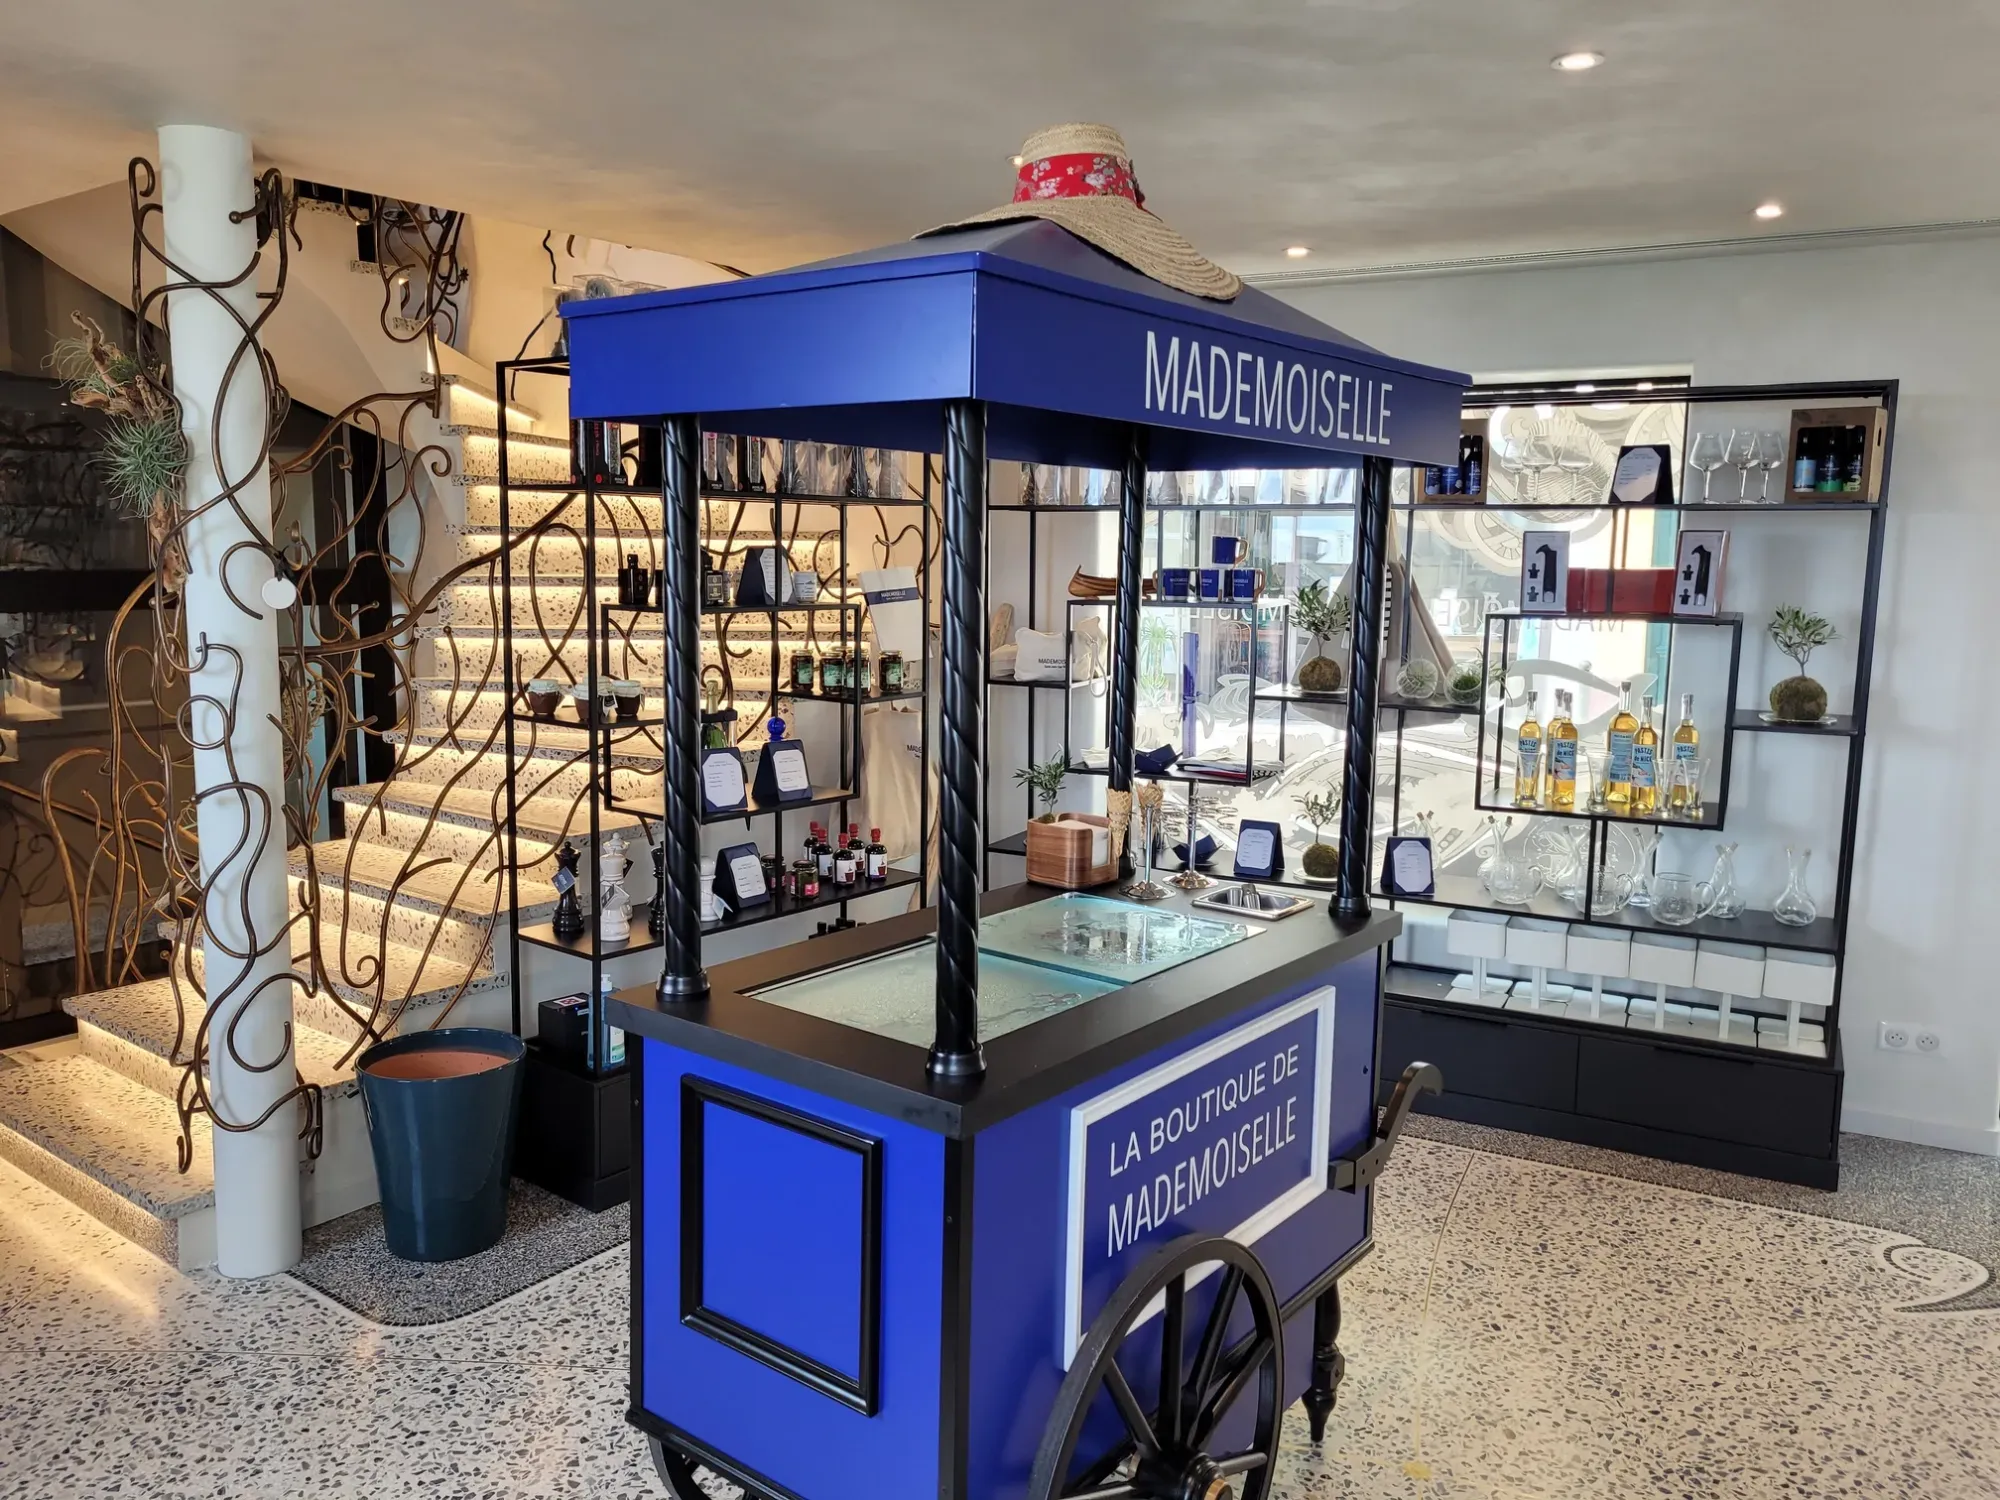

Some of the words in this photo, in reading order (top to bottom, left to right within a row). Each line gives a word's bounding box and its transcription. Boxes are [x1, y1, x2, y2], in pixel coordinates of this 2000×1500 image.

[1145, 330, 1393, 446] MADEMOISELLE
[1107, 1096, 1297, 1258] MADEMOISELLE
[1110, 1130, 1141, 1178] LA
[1150, 1061, 1266, 1155] BOUTIQUE
[1272, 1044, 1299, 1085] DE
